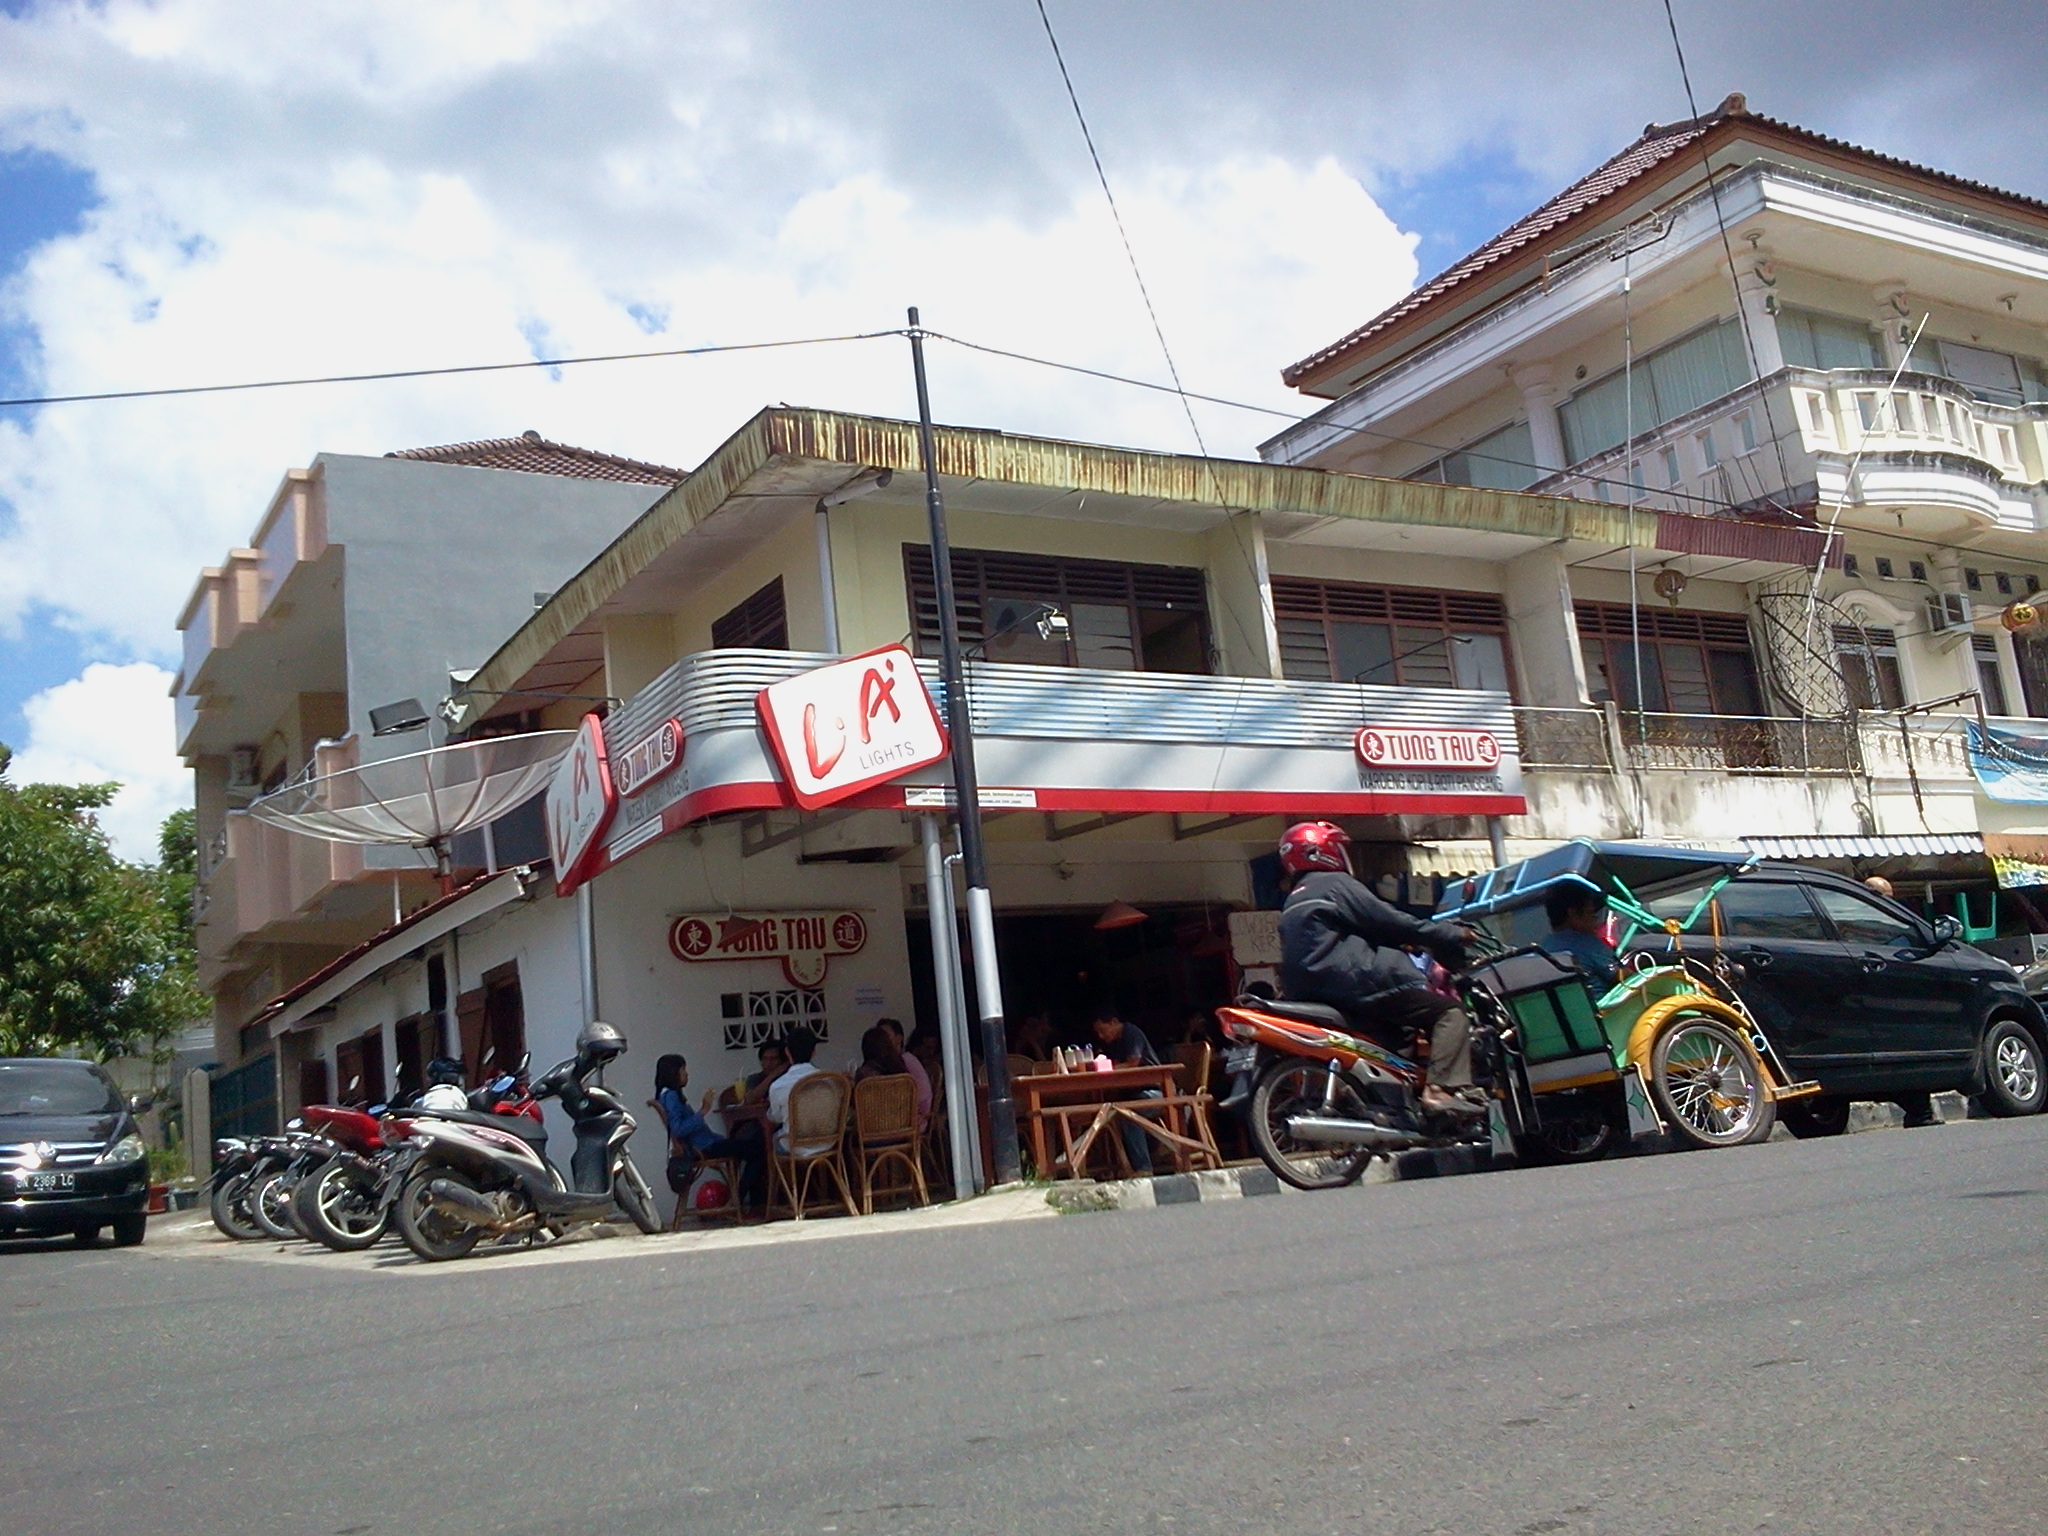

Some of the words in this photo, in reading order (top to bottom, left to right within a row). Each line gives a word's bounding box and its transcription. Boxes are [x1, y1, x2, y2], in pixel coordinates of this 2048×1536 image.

[860, 741, 915, 769] LIGHTS
[1385, 734, 1437, 761] TUNG
[1437, 735, 1475, 762] TAU
[782, 917, 827, 950] TAU
